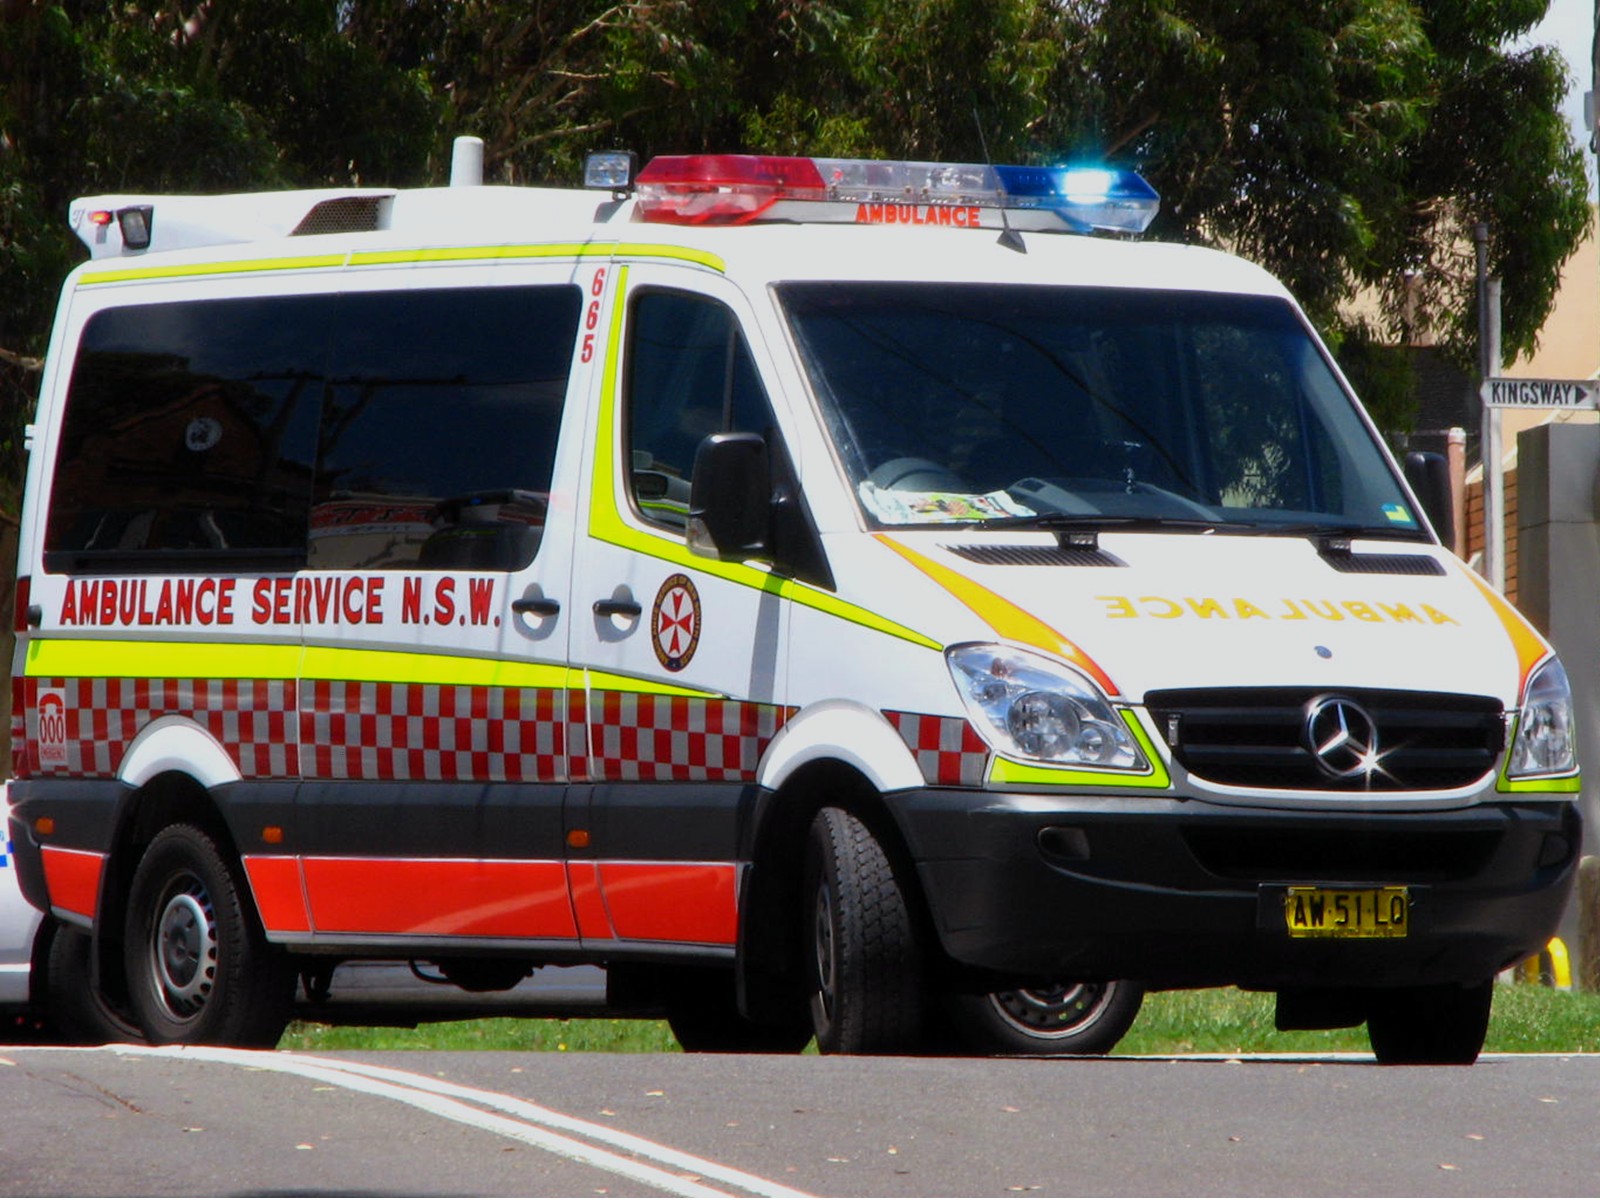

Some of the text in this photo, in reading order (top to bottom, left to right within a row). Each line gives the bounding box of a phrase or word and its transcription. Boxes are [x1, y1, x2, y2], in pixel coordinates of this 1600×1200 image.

[856, 203, 981, 228] AMBULANCE
[581, 267, 606, 363] 665
[1491, 382, 1572, 404] KINGSWAY
[60, 576, 500, 627] AMBULANCE SERVICE N.S.W.
